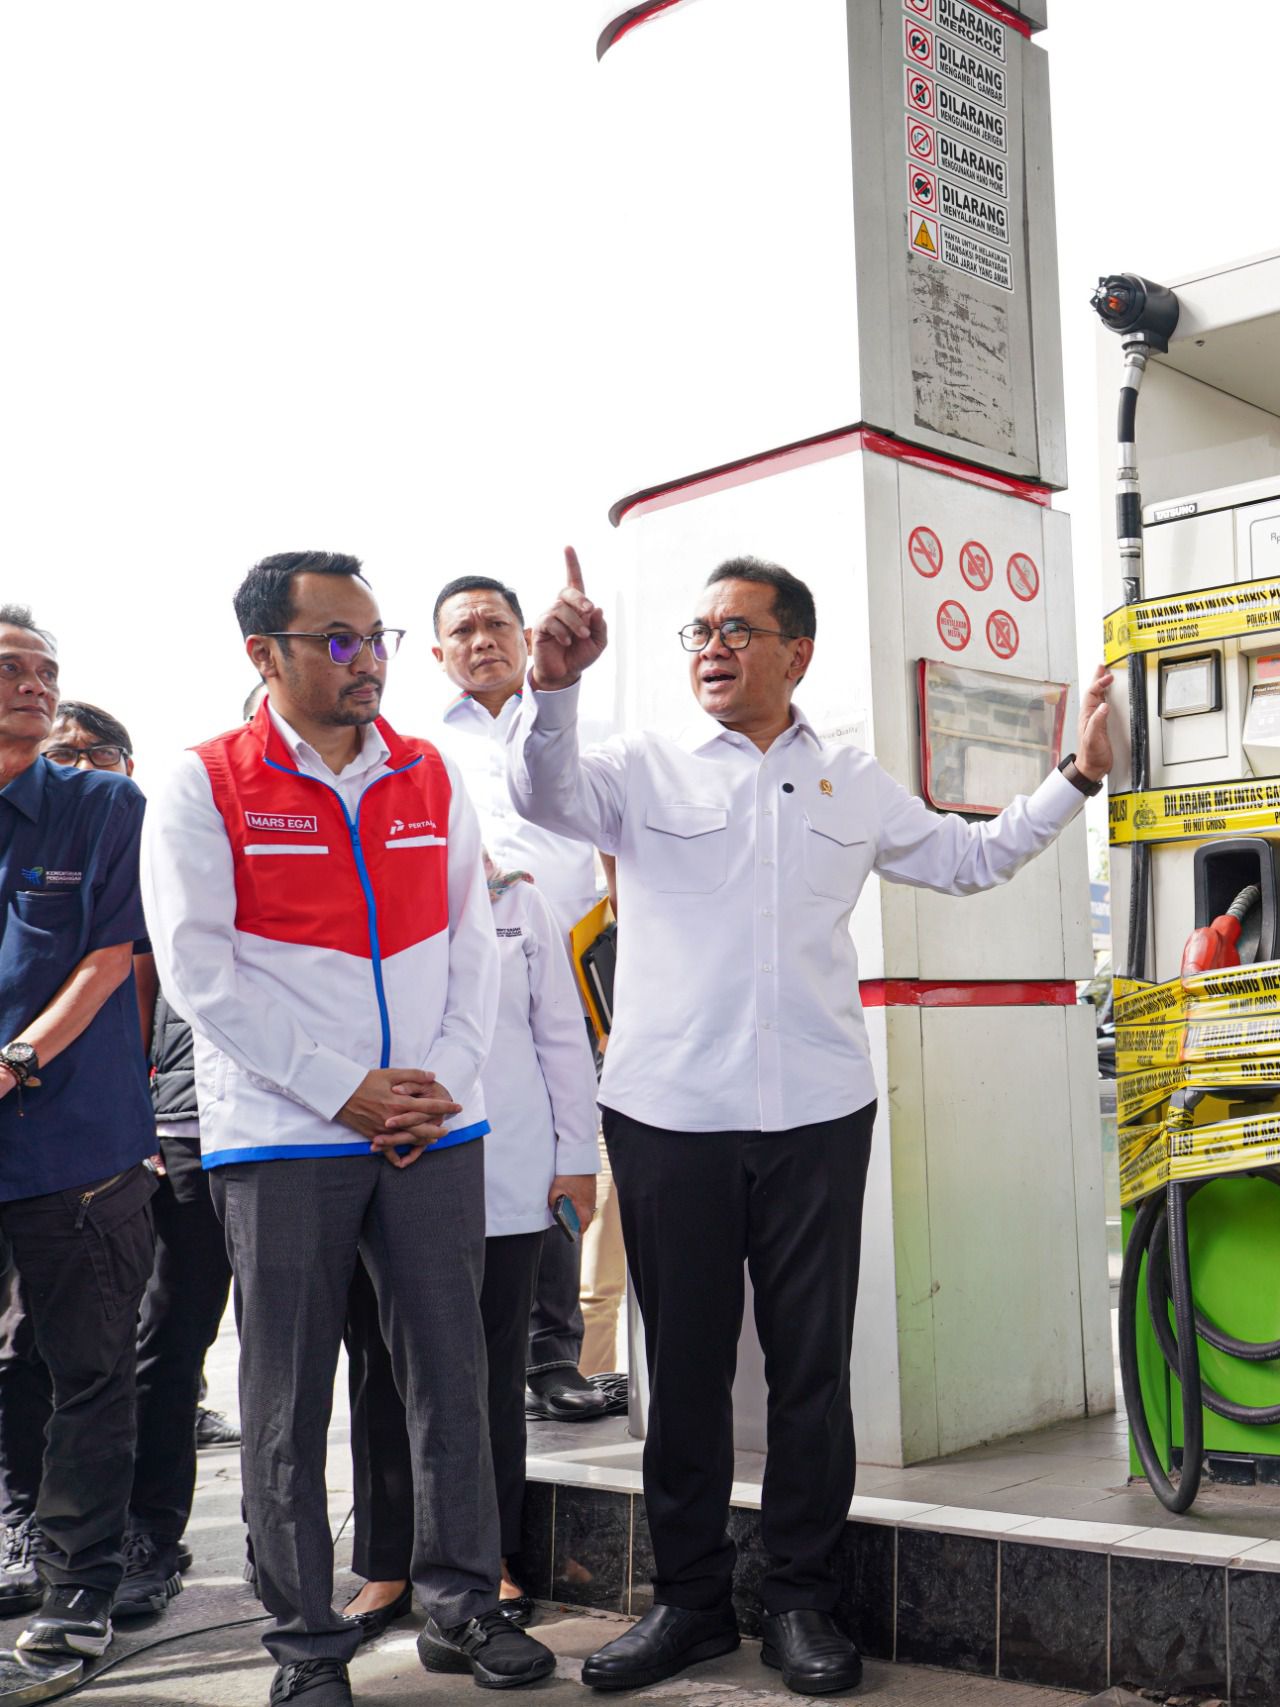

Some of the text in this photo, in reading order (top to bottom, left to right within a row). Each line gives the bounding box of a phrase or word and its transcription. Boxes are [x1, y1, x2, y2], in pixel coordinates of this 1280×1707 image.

[940, 0, 1002, 45] DILARANG
[940, 14, 1001, 56] MEROKOK
[940, 43, 1002, 90] DILARANG
[940, 61, 1002, 100] MENGAMBIL GAMBAR
[941, 91, 1003, 136] DILARANG
[941, 109, 980, 137] MENGGUNAKAN
[941, 138, 1003, 181] DILARANG
[942, 157, 976, 180] MENGGUNAKAN
[943, 185, 1005, 227] DILARANG
[944, 204, 1005, 238] MENYALAKAN MESIN
[945, 241, 974, 259] TRANSAKSI
[962, 239, 977, 251] UNTUK
[946, 251, 959, 264] PADA
[960, 259, 977, 273] JARAK
[979, 266, 992, 279] YANG
[1155, 504, 1195, 520] TATSUNO
[1247, 612, 1266, 626] POLICE
[1164, 788, 1212, 817] DILARANG
[1214, 784, 1263, 812] MELINTAS
[251, 817, 312, 829] MARS EGA
[1183, 816, 1227, 833] DO NOT CROSS
